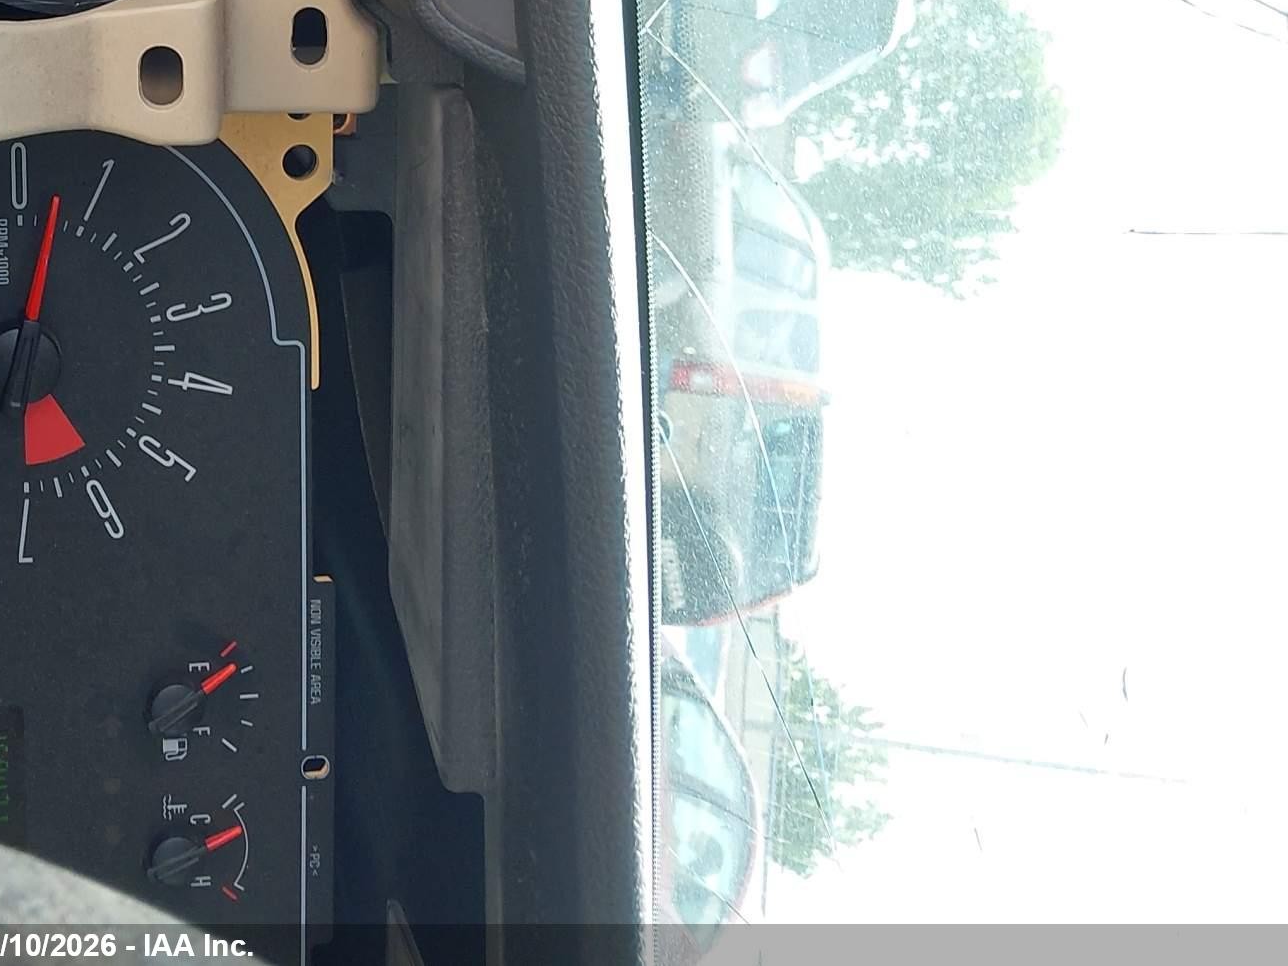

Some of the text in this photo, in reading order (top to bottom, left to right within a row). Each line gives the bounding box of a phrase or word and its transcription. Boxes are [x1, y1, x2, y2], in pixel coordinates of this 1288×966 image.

[11, 142, 28, 210] 0
[83, 158, 115, 222] 1
[133, 212, 192, 264] 2
[165, 291, 233, 323] 3
[167, 371, 234, 396] 4
[138, 434, 198, 483] 5
[17, 497, 34, 564] 7
[85, 478, 125, 539] 6
[188, 661, 211, 673] E
[310, 599, 322, 705] NON VISIBLE AREA
[192, 725, 211, 736] F
[189, 813, 212, 826] C
[190, 875, 212, 888] H
